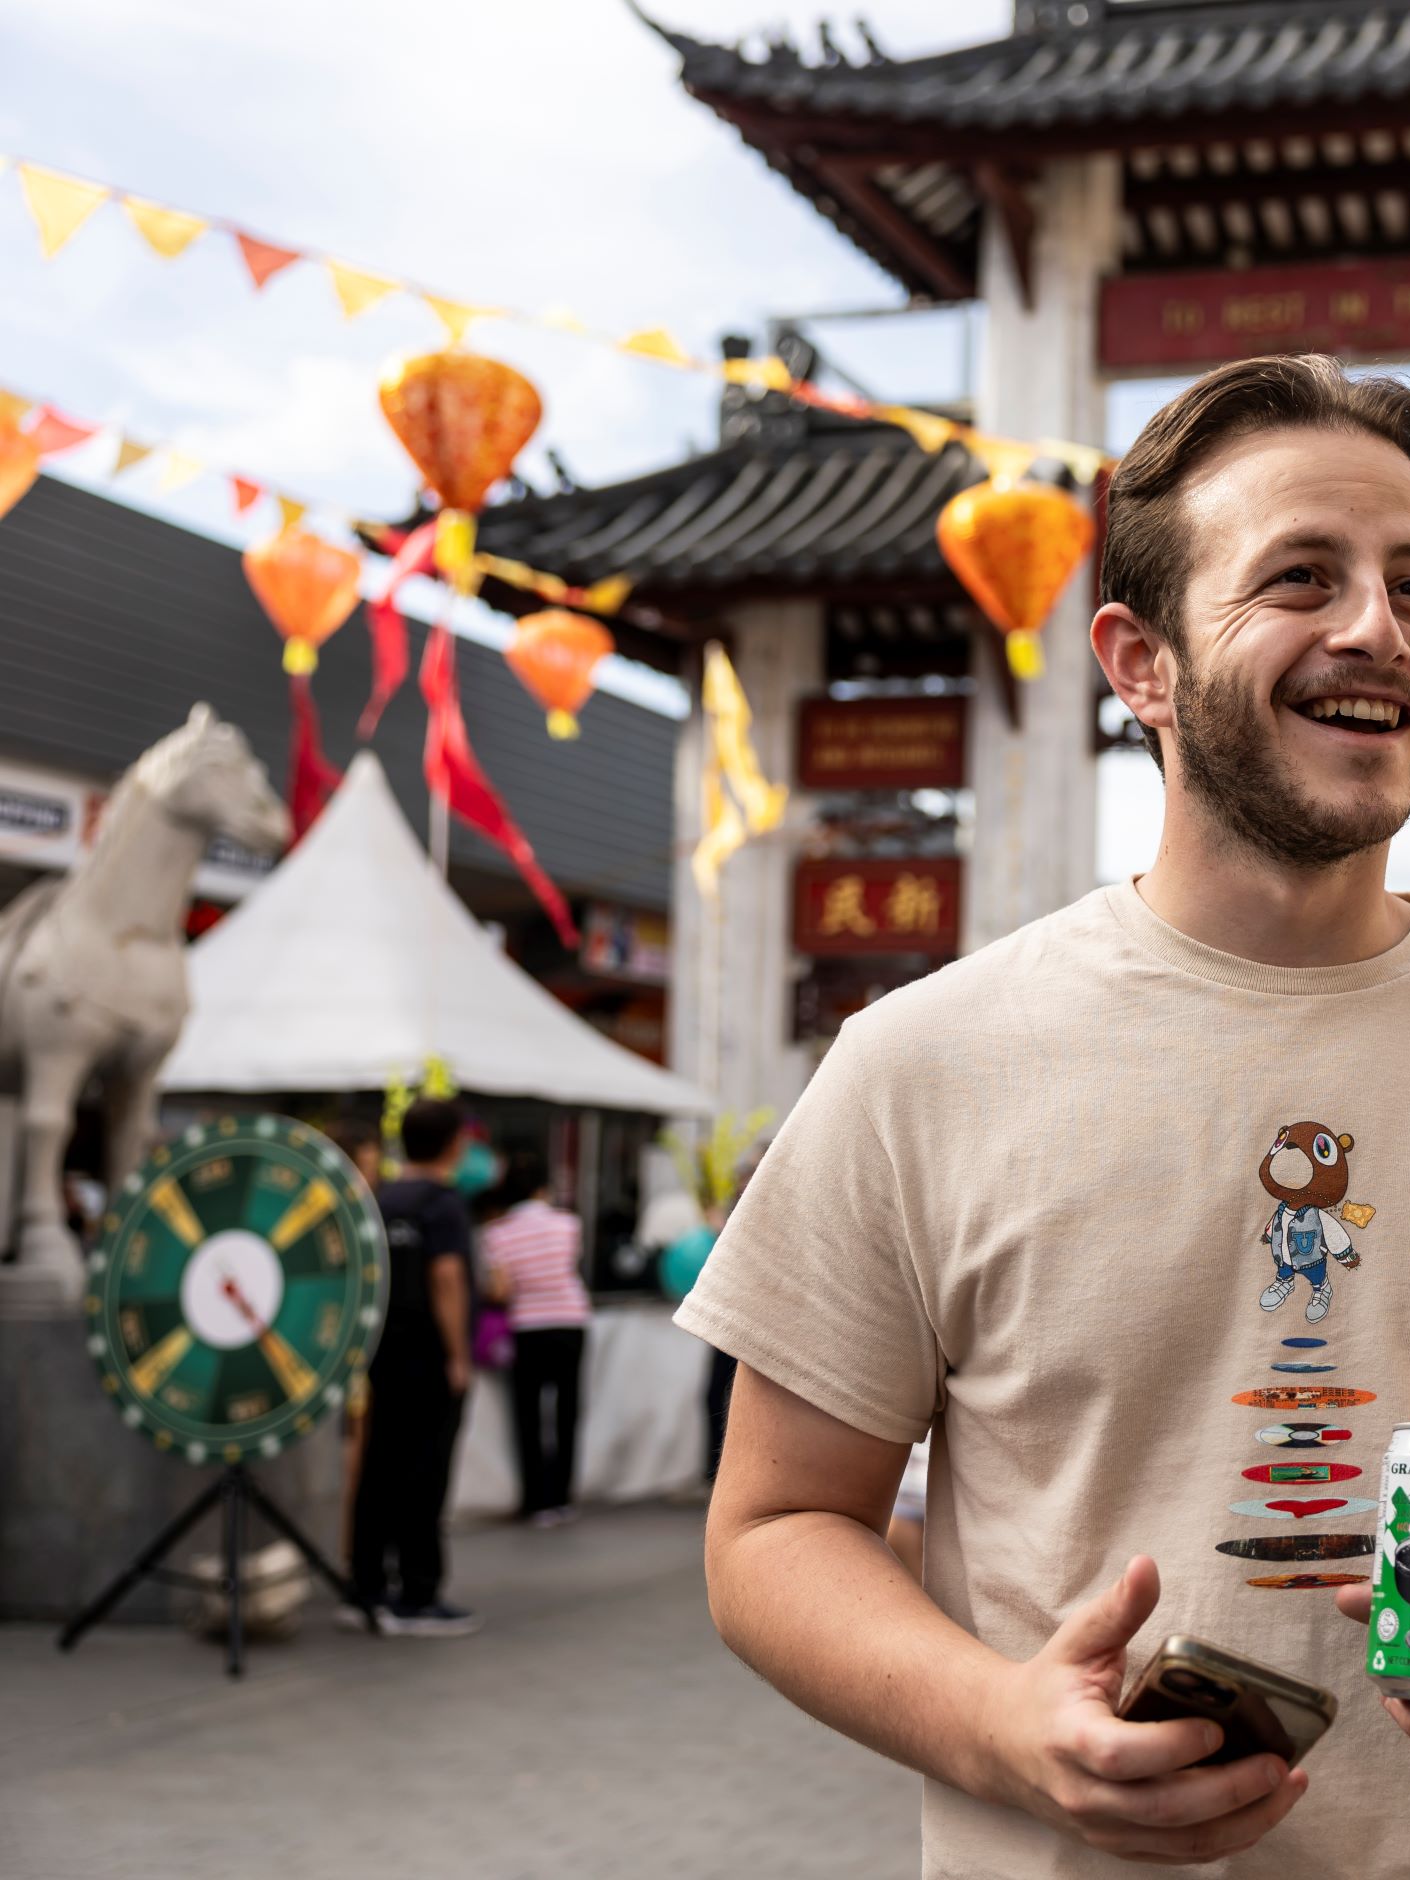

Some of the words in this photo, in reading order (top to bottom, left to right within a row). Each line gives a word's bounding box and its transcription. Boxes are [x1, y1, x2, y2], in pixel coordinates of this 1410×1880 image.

[1162, 298, 1204, 337] TO
[1222, 292, 1305, 331] REST
[1329, 290, 1370, 326] IN
